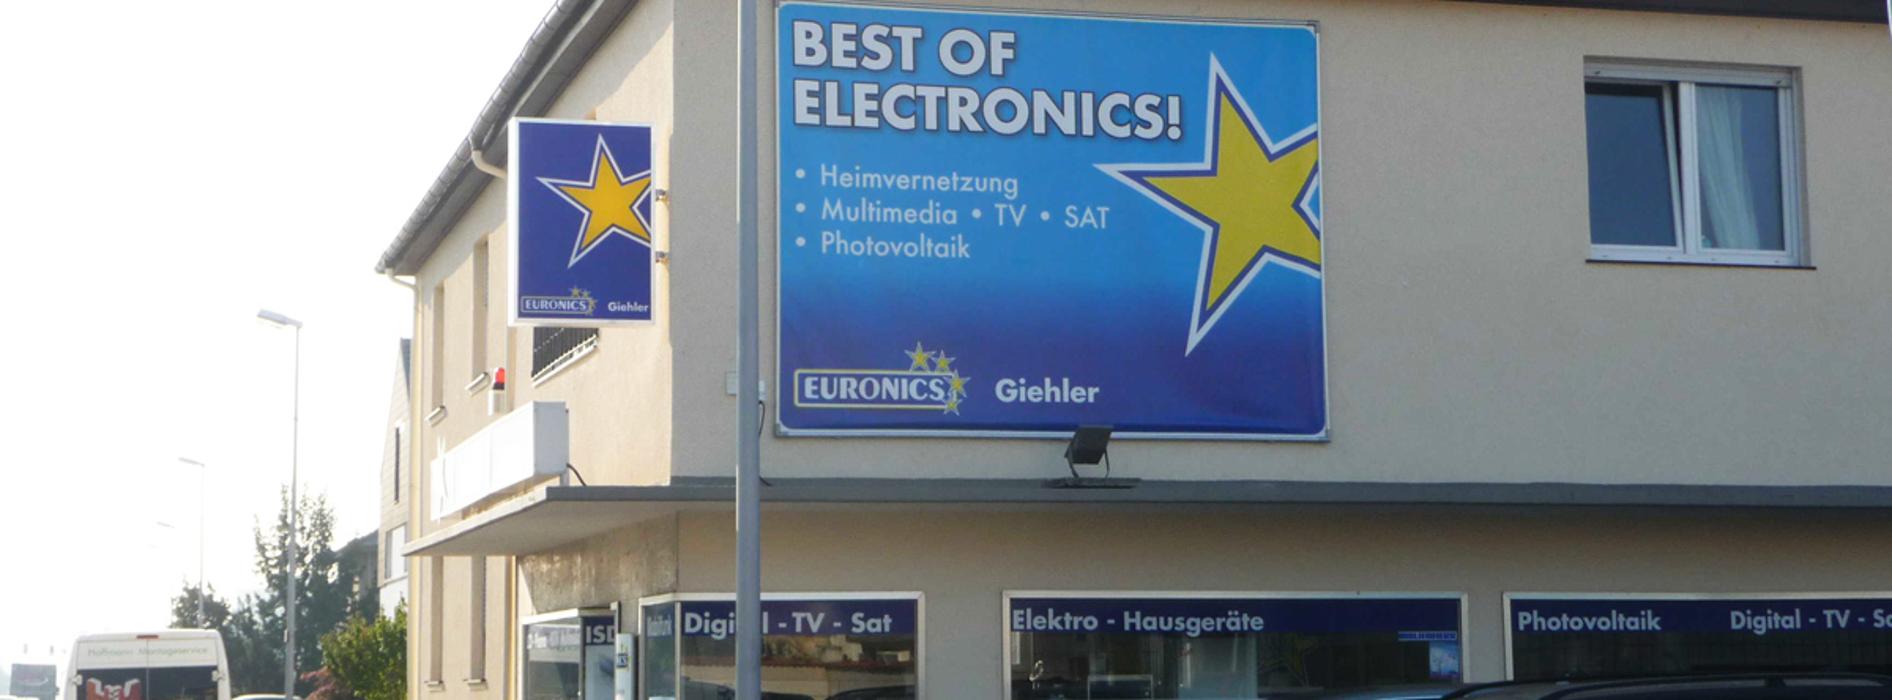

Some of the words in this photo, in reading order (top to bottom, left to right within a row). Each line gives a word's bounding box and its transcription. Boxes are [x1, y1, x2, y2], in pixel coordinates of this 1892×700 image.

[793, 20, 923, 72] BEST
[938, 28, 1016, 76] OF
[793, 79, 1184, 141] ELECTRONICS!
[820, 164, 1018, 200] Heimvernetzung
[821, 198, 958, 226] Multimedia
[995, 204, 1027, 227] TV
[1064, 205, 1110, 229] SAT
[821, 231, 970, 259] Photovoltaik
[524, 298, 587, 311] EURONICS
[607, 302, 649, 313] Giehler
[804, 376, 945, 402] EURONICS
[995, 378, 1100, 403] Giehler
[684, 611, 769, 641] Digil
[792, 612, 825, 631] TV
[851, 612, 893, 634] Sat
[1011, 607, 1098, 632] Elektro
[1123, 611, 1265, 637] Hausgeräte
[1517, 610, 1662, 632] Photovoltaik
[1730, 608, 1801, 636] Digital
[1822, 609, 1851, 629] TV
